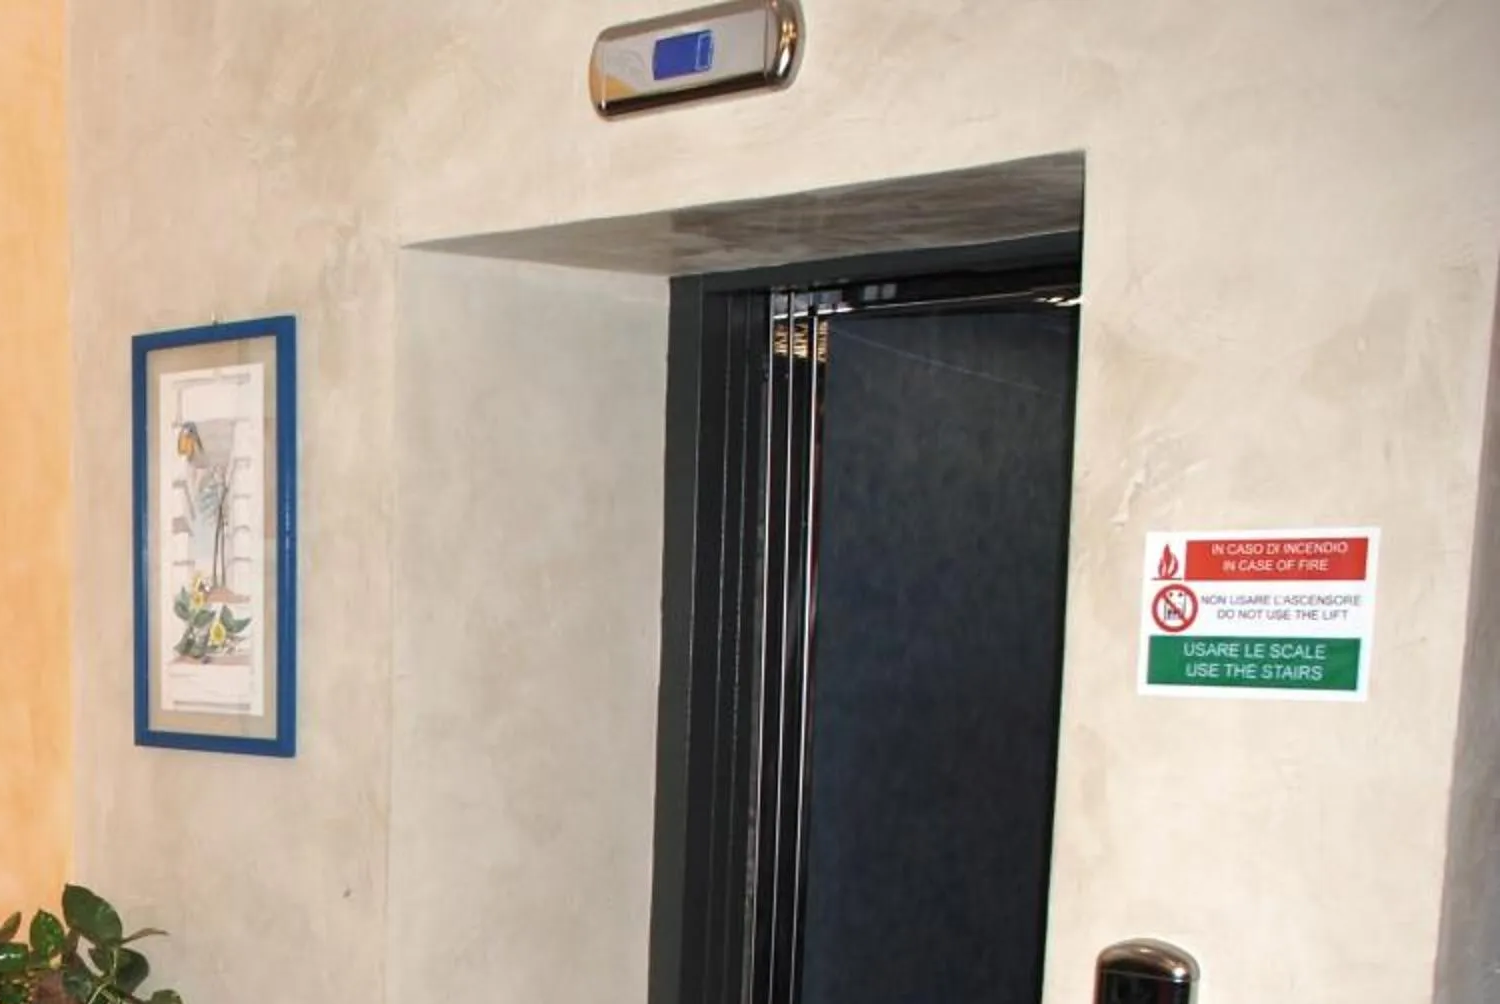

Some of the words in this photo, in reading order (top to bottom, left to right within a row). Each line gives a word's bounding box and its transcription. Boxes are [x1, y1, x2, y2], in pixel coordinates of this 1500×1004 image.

[1211, 543, 1225, 556] IN
[1226, 543, 1264, 556] CASO
[1267, 543, 1280, 555] DI
[1283, 541, 1349, 555] INCENDIO
[1222, 560, 1236, 572] IN
[1238, 560, 1273, 572] CASE
[1276, 559, 1292, 572] OF
[1299, 559, 1329, 572] FIRE
[1201, 594, 1227, 605] NON
[1230, 594, 1270, 606] USARE
[1217, 609, 1235, 620] DO
[1238, 609, 1263, 620] NOT
[1266, 609, 1292, 621] USE
[1295, 609, 1319, 621] THE
[1322, 609, 1349, 621] LIFT
[1183, 642, 1240, 659] USARE
[1244, 643, 1265, 659] LE
[1269, 643, 1327, 660] SCALE
[1185, 663, 1220, 678] USE
[1224, 663, 1257, 679] THE
[1261, 664, 1324, 681] STAIRS
